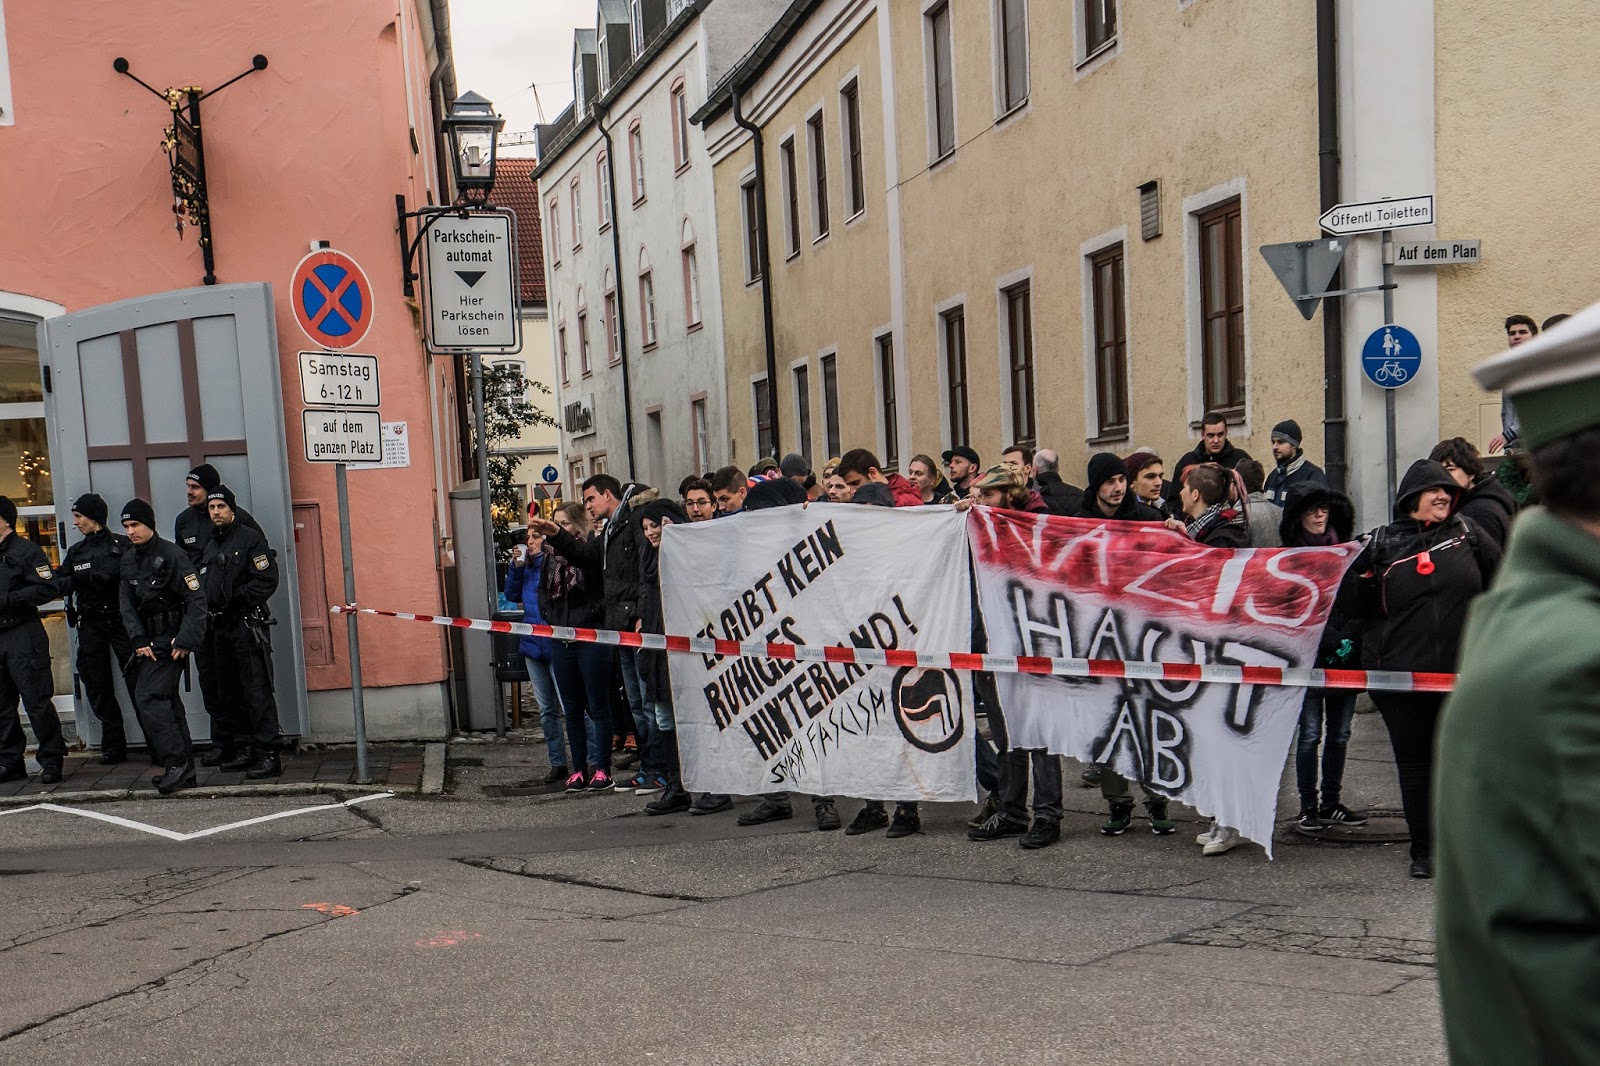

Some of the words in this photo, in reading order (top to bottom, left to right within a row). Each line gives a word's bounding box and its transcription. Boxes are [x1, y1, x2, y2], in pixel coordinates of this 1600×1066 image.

[1377, 206, 1428, 221] Toiletten
[434, 229, 502, 243] Parkschein-
[446, 249, 493, 262] automat
[1398, 246, 1418, 260] Auf
[1424, 245, 1447, 259] dem
[1453, 244, 1477, 258] Plan
[459, 295, 484, 306] Hier
[441, 310, 504, 321] Parkschein
[458, 325, 489, 336] lösen
[309, 359, 370, 381] Samstag
[323, 419, 337, 433] auf
[342, 419, 363, 433] dem
[314, 442, 347, 457] ganzen
[351, 440, 374, 454] Platz
[73, 562, 91, 572] POLIZEI
[981, 505, 1348, 628] NAZIS
[720, 572, 778, 641] GIBT
[777, 519, 844, 598] KEIN
[1014, 586, 1290, 727] HAUT
[702, 616, 806, 732] RUHIGES
[771, 738, 807, 787] SMASH
[806, 686, 886, 763] FASCISM
[1096, 701, 1187, 790] AB
